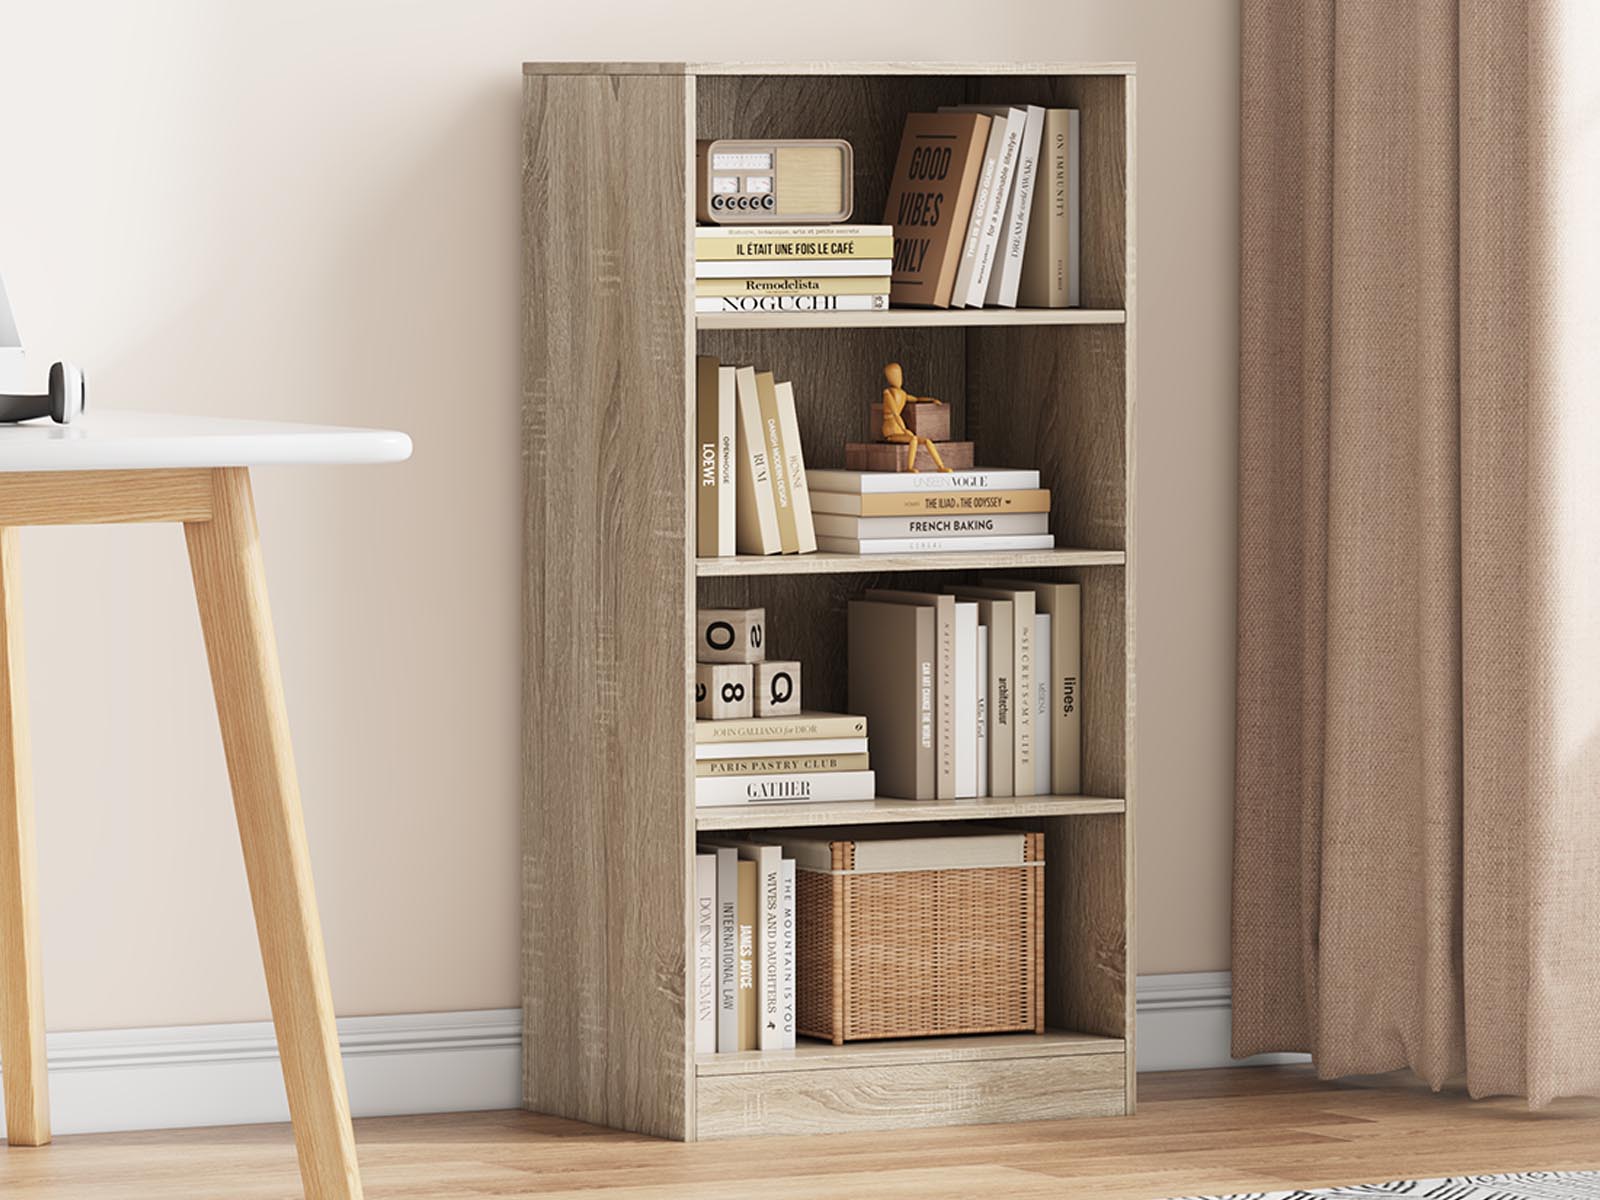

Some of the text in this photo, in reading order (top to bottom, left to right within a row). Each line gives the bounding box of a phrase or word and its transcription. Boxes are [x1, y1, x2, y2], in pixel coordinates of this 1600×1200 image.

[908, 146, 952, 181] GOOD
[1056, 133, 1065, 218] ON IMMUNITY
[986, 225, 995, 237] for
[993, 166, 1009, 215] sustainable
[1003, 132, 1017, 165] lifestyle
[897, 192, 944, 227] VIBES
[736, 242, 854, 255] IL ÉTAIT UNE FOIS LE CAFÉ
[892, 238, 930, 273] ONLY
[746, 279, 820, 291] Remodelista
[722, 295, 838, 311] NOGUCHI
[702, 443, 715, 487] LOEWE
[951, 475, 988, 487] VOGUE
[925, 498, 938, 509] THE
[939, 498, 955, 508] ILIAD
[961, 497, 973, 508] THE
[973, 497, 1002, 508] ODYSSEY
[910, 519, 993, 532] FRENCH BAKING
[1021, 638, 1029, 699] SECRETS
[721, 682, 745, 703] 8
[1063, 677, 1076, 717] lines.
[1021, 707, 1029, 725] MY
[710, 759, 838, 773] PARIS PASTRY CLUB
[1021, 734, 1029, 764] LIFE
[747, 781, 811, 798] GATHER
[722, 902, 735, 1010] INTERNATIONAL LAW
[740, 925, 752, 990] JAMES JOYCE
[767, 872, 777, 1014] WIVES AND DAUGHTERS
[784, 879, 793, 1033] THE MOUNTAIN IS YOU
